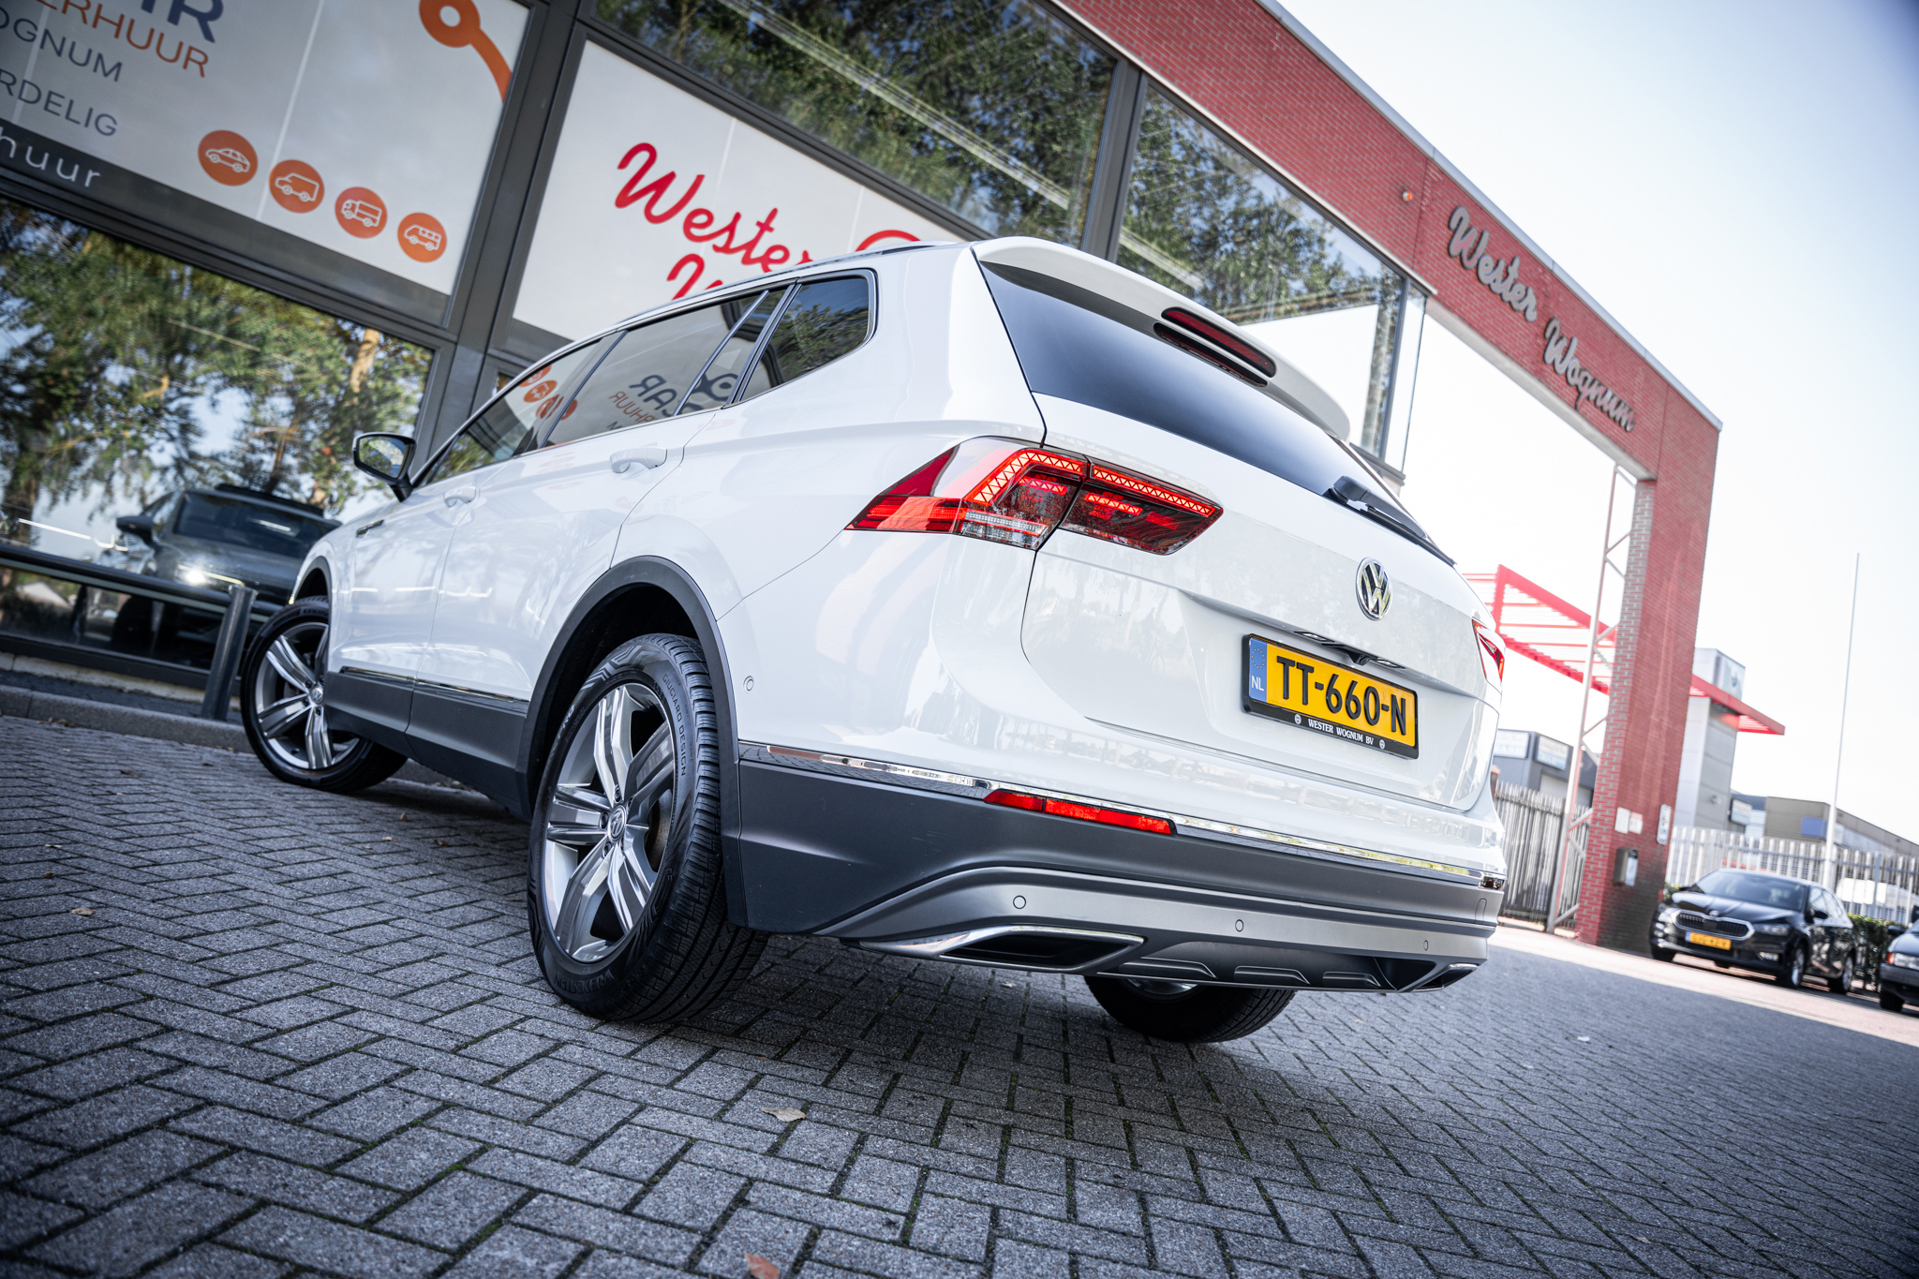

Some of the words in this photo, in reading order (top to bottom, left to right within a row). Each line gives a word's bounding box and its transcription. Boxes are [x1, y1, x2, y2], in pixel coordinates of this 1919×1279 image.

[36, 0, 208, 77] RHUUR
[140, 0, 223, 43] R
[1448, 205, 1538, 323] Wester
[1544, 316, 1636, 433] Wognum
[1251, 674, 1265, 692] NL
[1276, 655, 1407, 736] TT-660-N
[1307, 718, 1334, 734] WESTER
[1335, 726, 1364, 743] WOGNUM
[1365, 735, 1375, 746] BV
